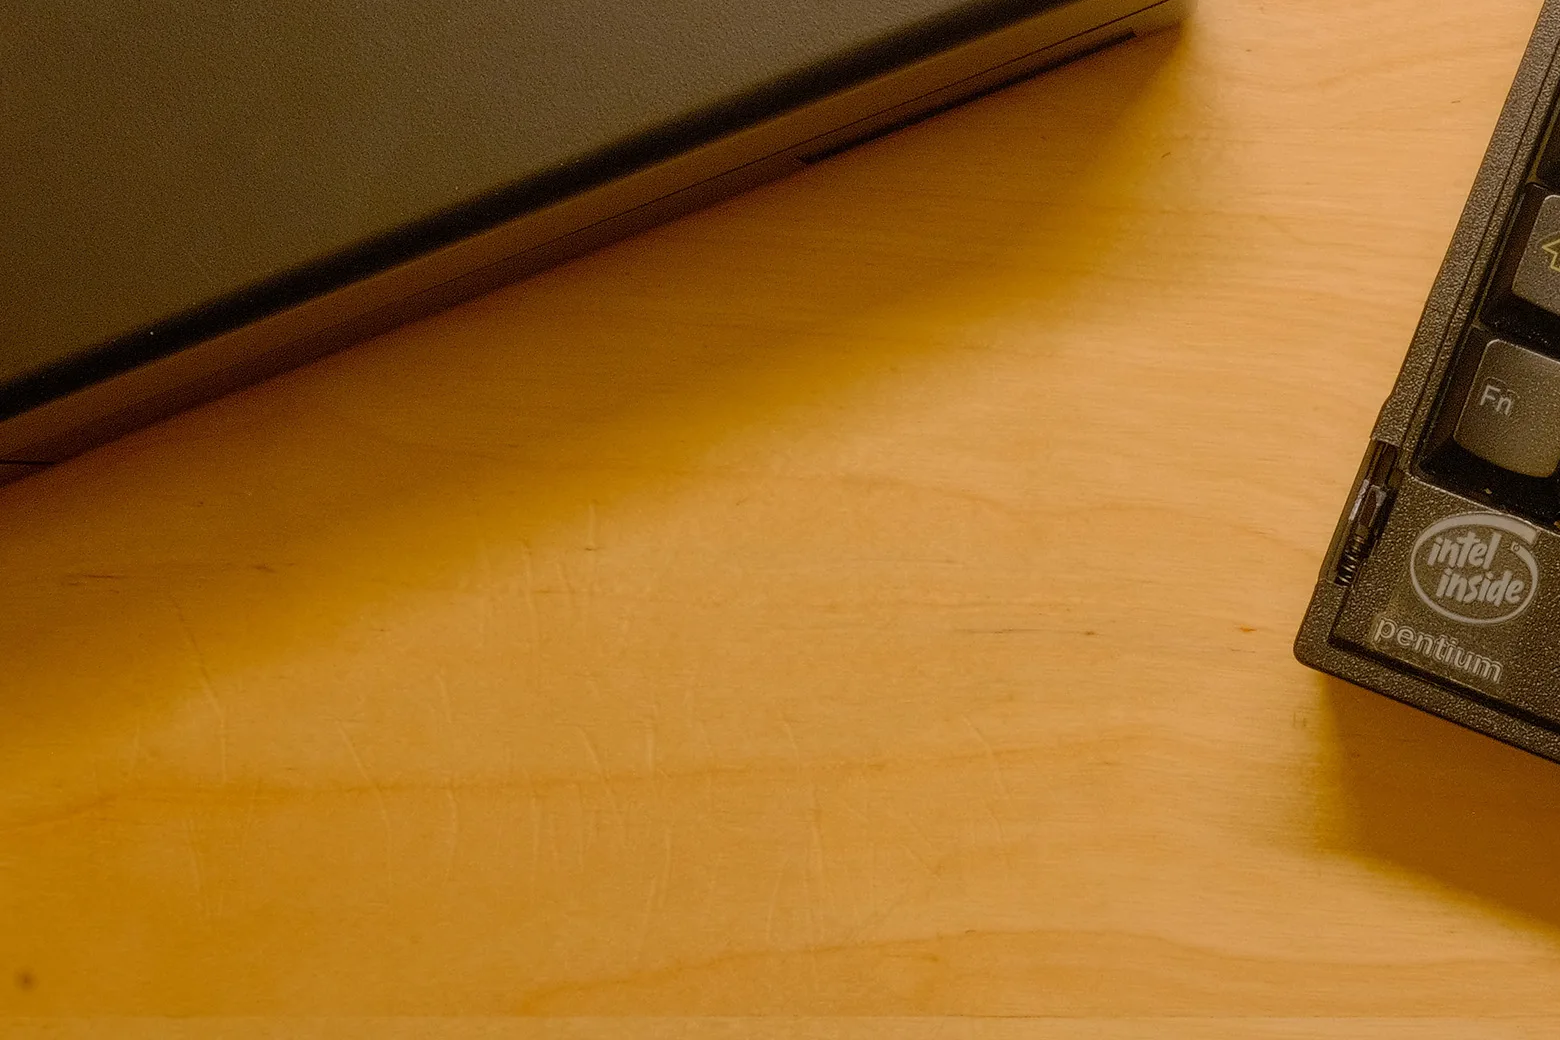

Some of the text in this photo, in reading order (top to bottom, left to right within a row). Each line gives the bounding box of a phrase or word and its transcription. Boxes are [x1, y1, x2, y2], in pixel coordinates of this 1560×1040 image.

[1479, 384, 1514, 416] Fn
[1427, 531, 1500, 569] intel
[1436, 568, 1525, 607] inside
[1374, 618, 1503, 684] pentium
